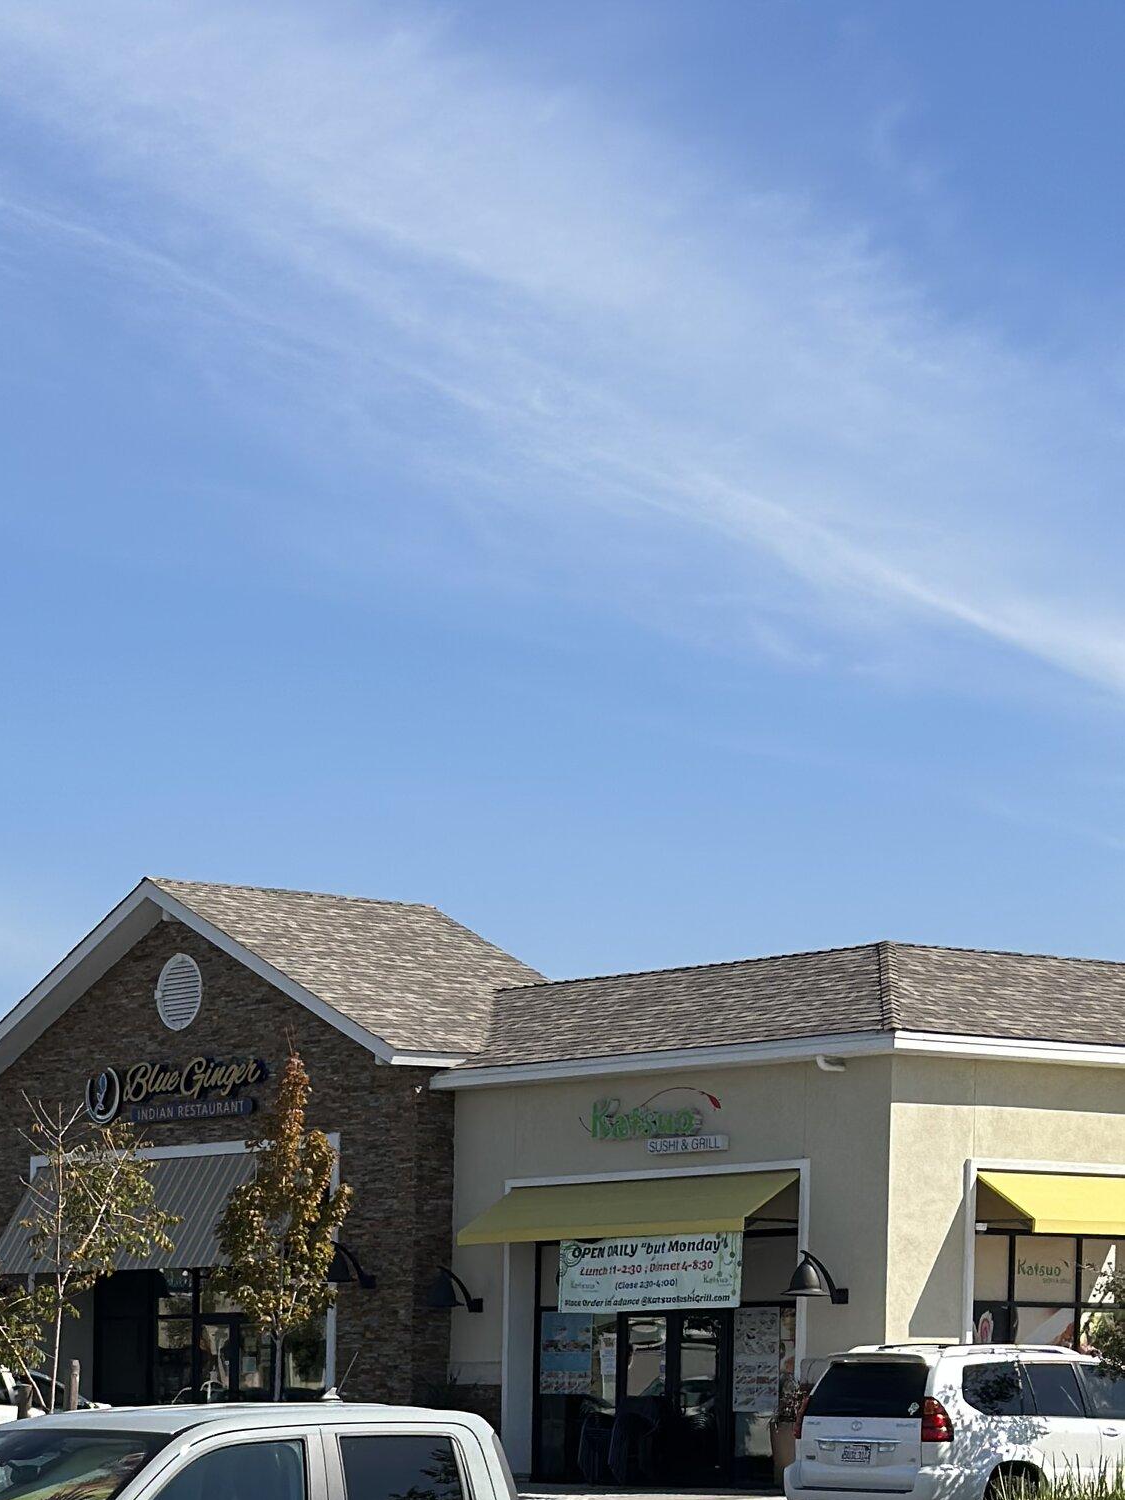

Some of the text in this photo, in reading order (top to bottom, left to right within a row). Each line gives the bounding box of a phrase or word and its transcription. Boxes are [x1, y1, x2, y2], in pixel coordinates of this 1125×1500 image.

[125, 1057, 261, 1101] Blue Ginger
[138, 1101, 244, 1121] INDIAN RESTAURANT
[591, 1098, 696, 1138] Katsuo
[649, 1138, 720, 1153] SUSHI & GRILL
[572, 1246, 606, 1259] OPEN
[607, 1244, 638, 1258] DAILY
[580, 1266, 608, 1276] Lunch
[650, 1261, 680, 1272] Dinner
[681, 1260, 714, 1272] 4-8:30
[1017, 1259, 1061, 1276] Katsuo
[583, 1299, 603, 1307] Order
